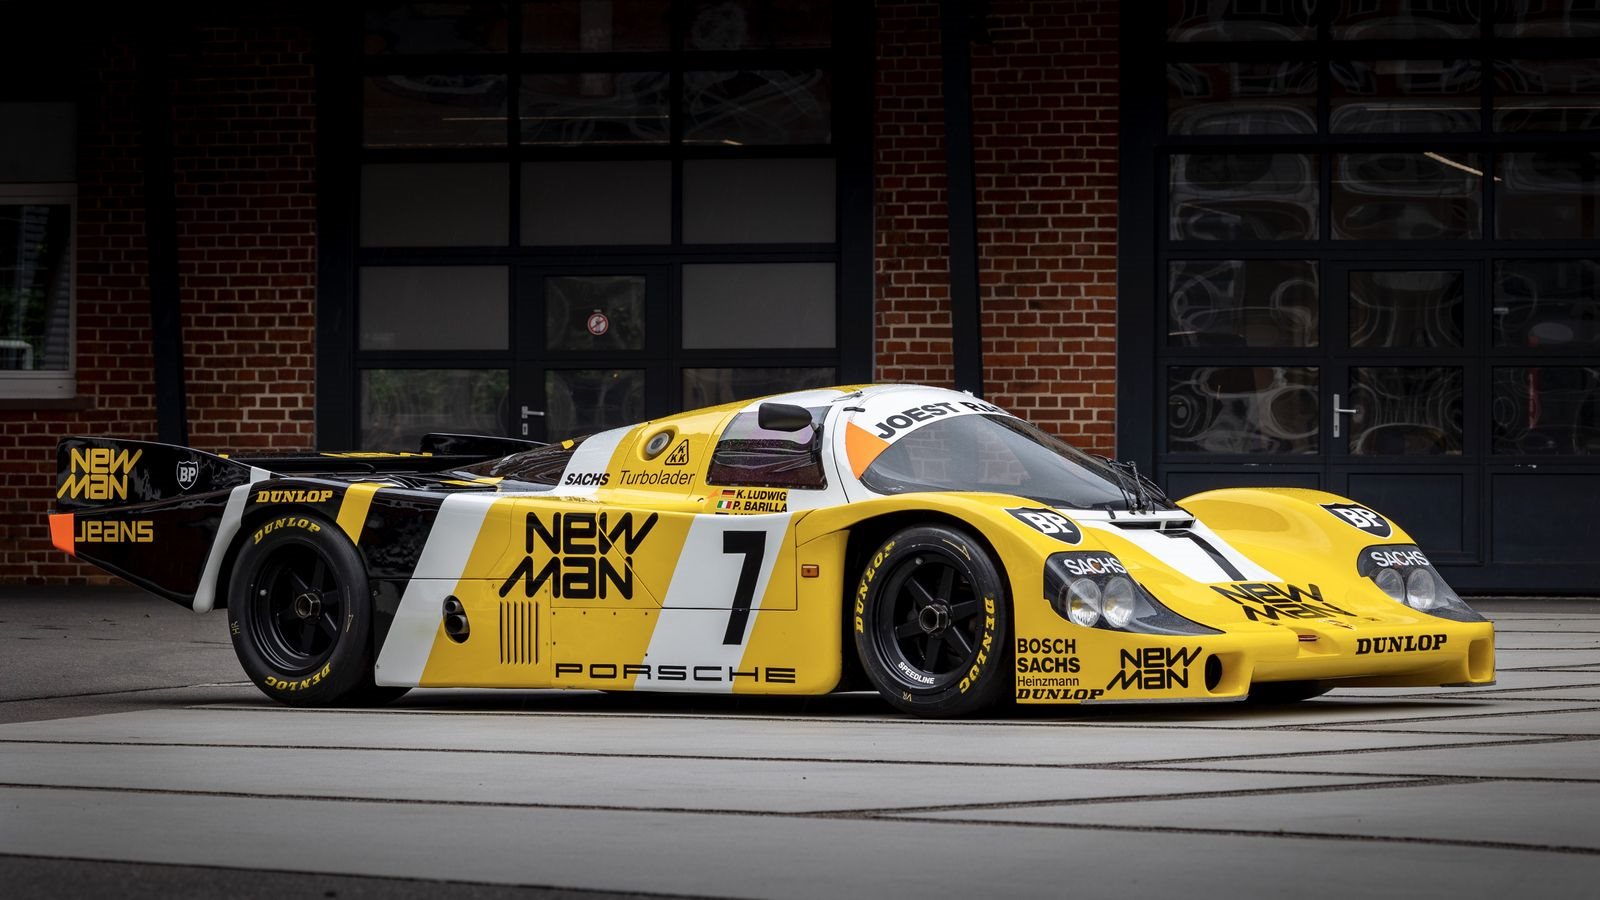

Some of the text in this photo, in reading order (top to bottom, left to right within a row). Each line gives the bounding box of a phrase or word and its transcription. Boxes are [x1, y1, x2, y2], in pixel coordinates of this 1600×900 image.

[875, 402, 960, 439] JOEST
[179, 467, 197, 482] BP
[565, 473, 610, 486] SACHS
[620, 470, 695, 485] Turbolader
[256, 490, 333, 503] DUNLOP
[744, 501, 787, 513] BARILLA
[1018, 512, 1073, 533] BP
[1331, 508, 1383, 528] BP
[253, 517, 321, 545] DUNLOP
[1154, 529, 1248, 581] 7
[1370, 551, 1430, 567] SACHS
[1064, 557, 1127, 575] SACHS
[723, 530, 767, 645] 7
[959, 597, 996, 694] DENLOC
[1017, 638, 1076, 654] BOSCH
[1355, 634, 1447, 655] DUNLOP
[555, 663, 796, 683] PORSCHE
[898, 661, 935, 685] SPEEDLINE
[1017, 657, 1081, 673] SACHS
[264, 662, 331, 691] DENLOC
[1017, 675, 1080, 687] Heinzmann
[1016, 688, 1104, 700] DUNLOP
